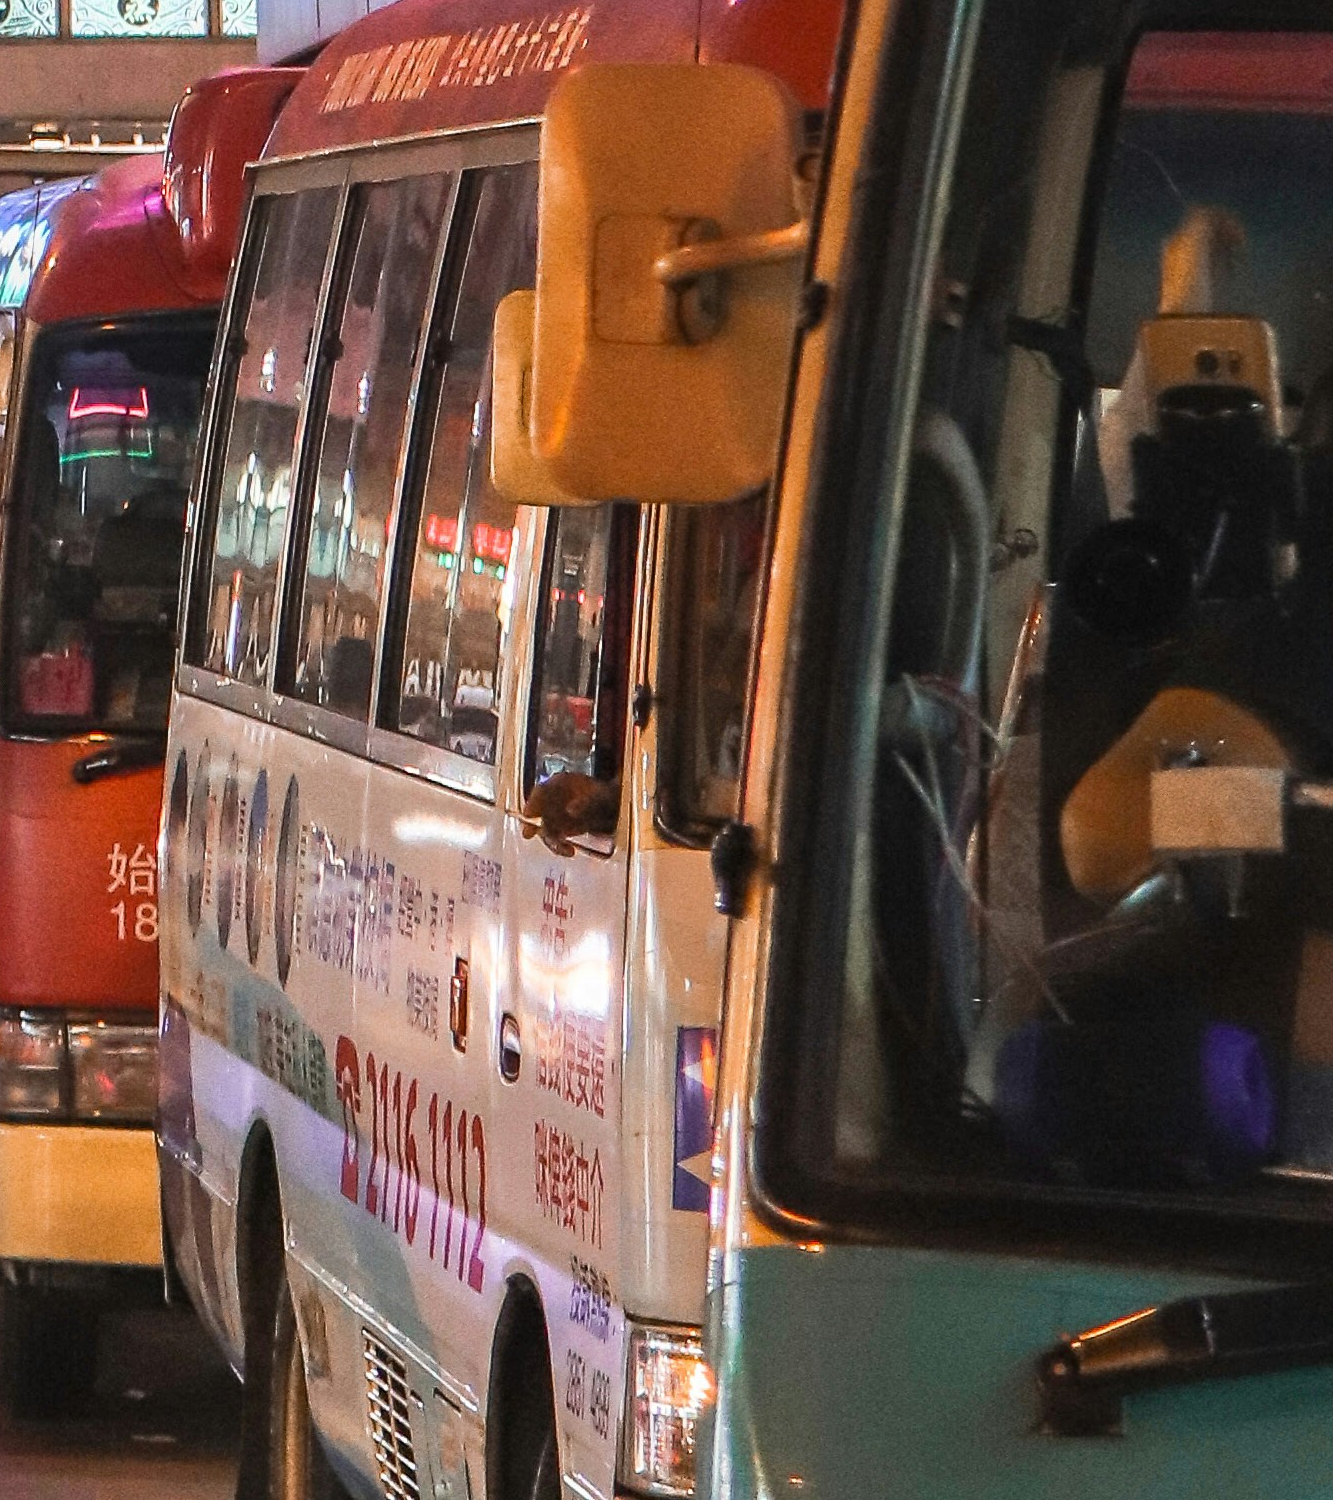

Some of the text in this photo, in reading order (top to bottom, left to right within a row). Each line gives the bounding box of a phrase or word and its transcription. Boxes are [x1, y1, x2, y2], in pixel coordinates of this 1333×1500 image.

[107, 842, 156, 896] 始
[110, 900, 158, 942] 18
[365, 1051, 421, 1247] 2116
[428, 1091, 487, 1295] 1112
